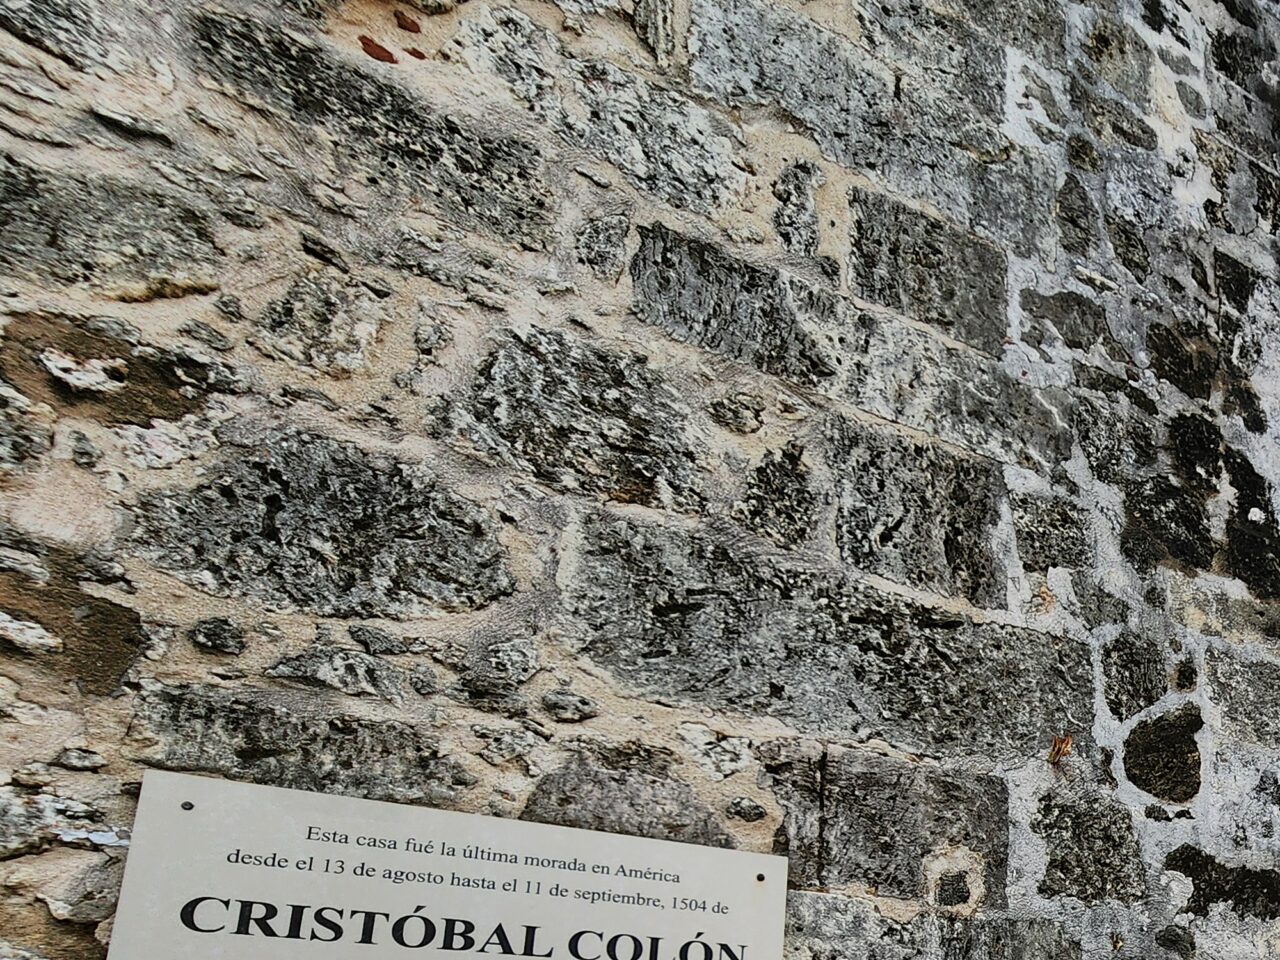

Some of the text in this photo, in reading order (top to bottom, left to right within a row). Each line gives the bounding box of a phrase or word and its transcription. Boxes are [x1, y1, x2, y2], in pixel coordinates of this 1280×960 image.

[227, 849, 728, 914] desde el 13 de agosto hasta el 11 de septiembre, 1504 de
[306, 826, 680, 883] Esta casa fué la última morada en América
[180, 897, 554, 958] CRISTÓBAL
